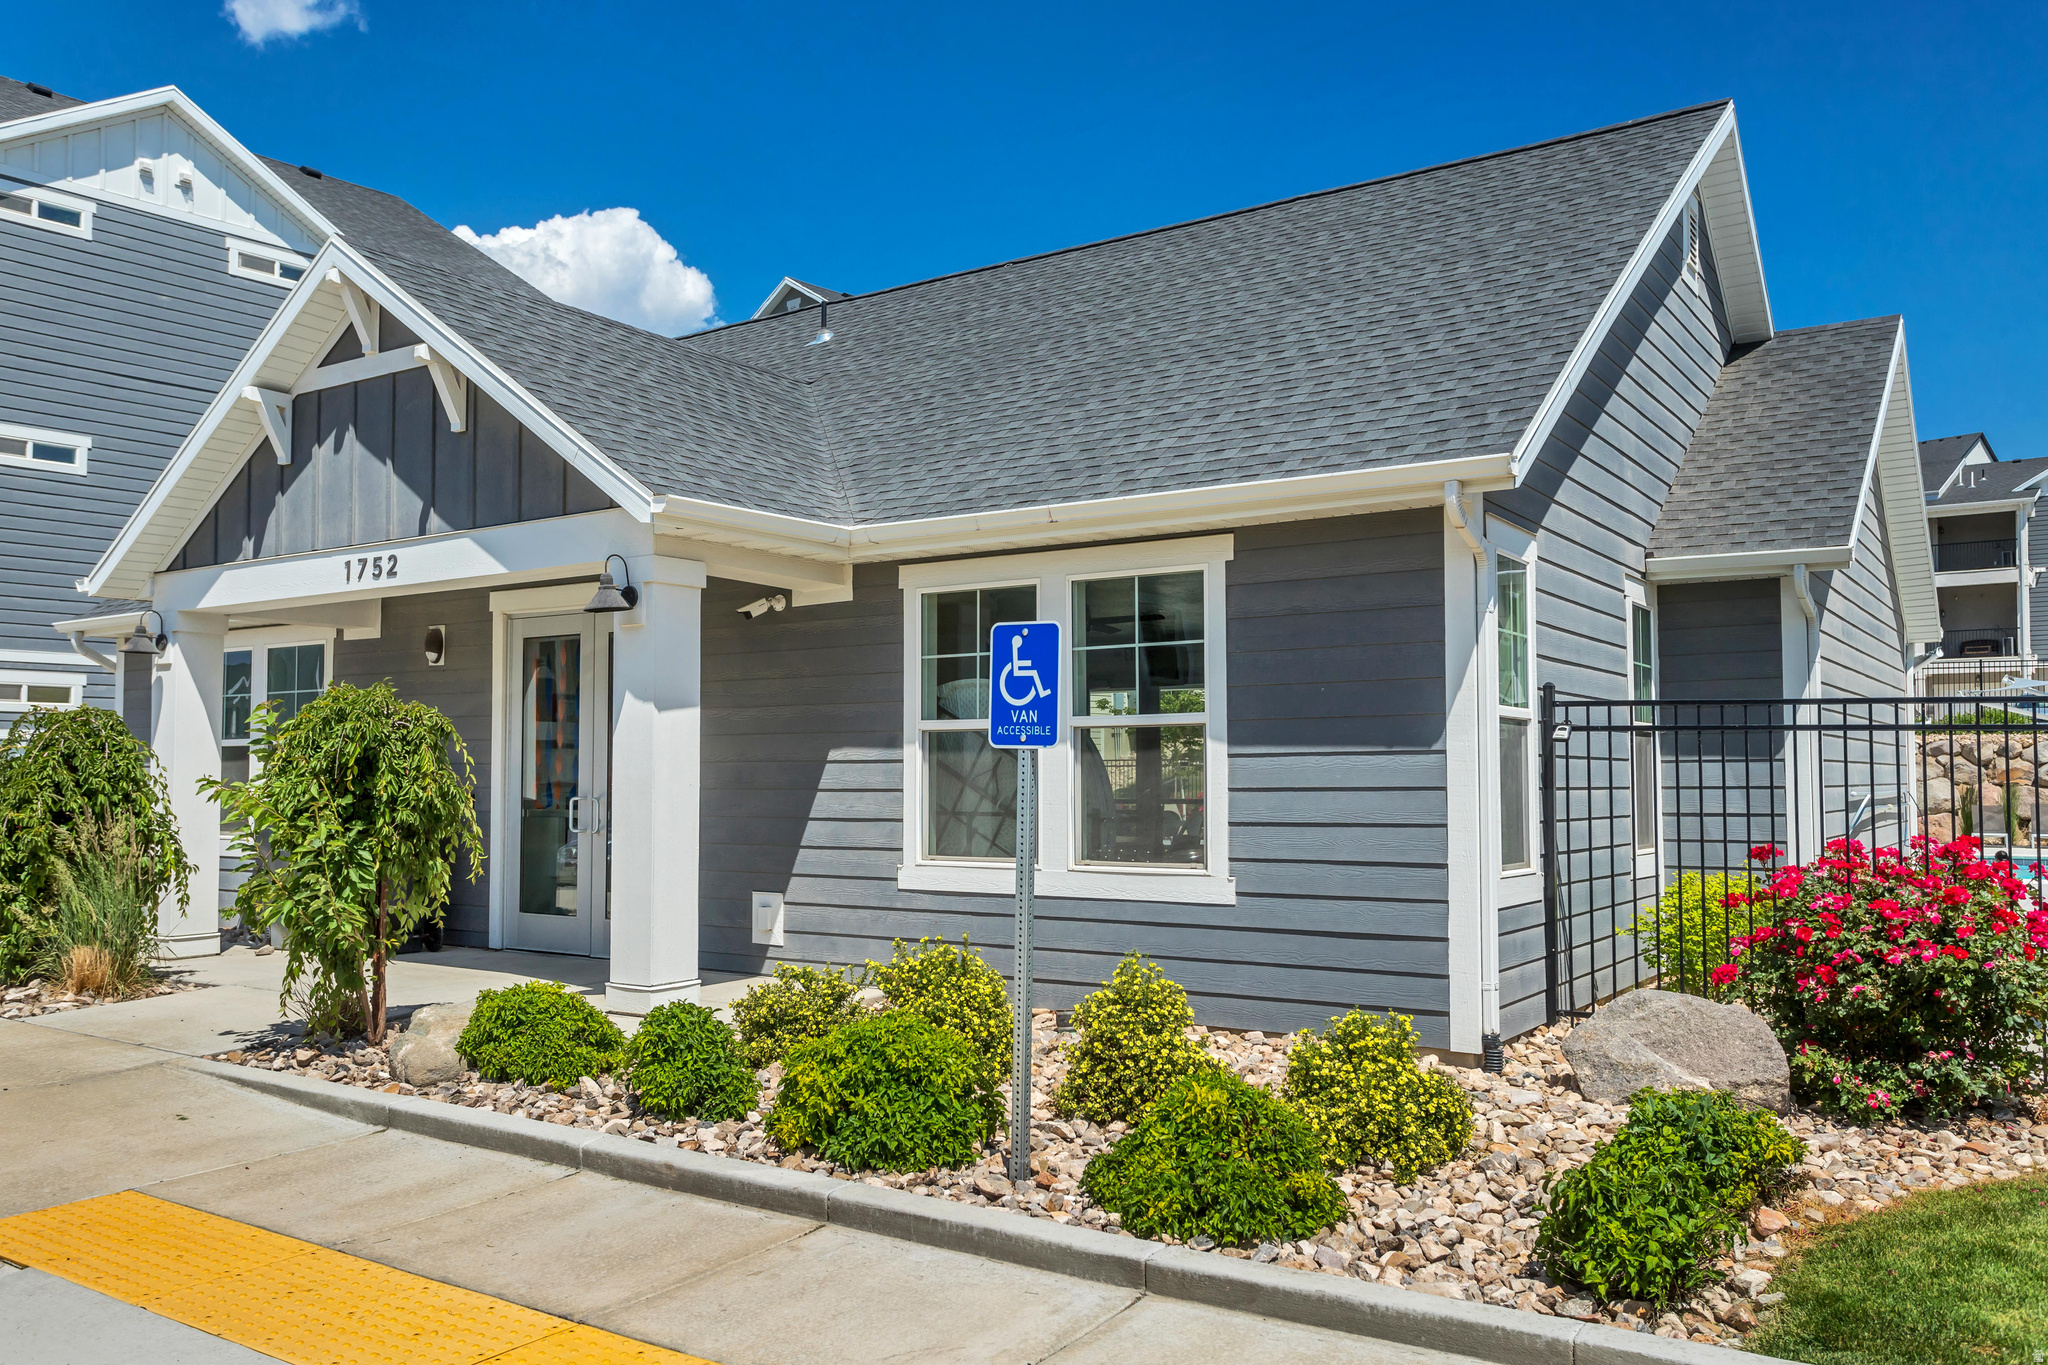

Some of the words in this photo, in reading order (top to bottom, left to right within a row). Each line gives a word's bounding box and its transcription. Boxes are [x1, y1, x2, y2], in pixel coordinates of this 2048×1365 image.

[344, 554, 398, 583] 1752
[1011, 709, 1038, 723] VAN
[996, 725, 1051, 736] ACCESSIBLE
